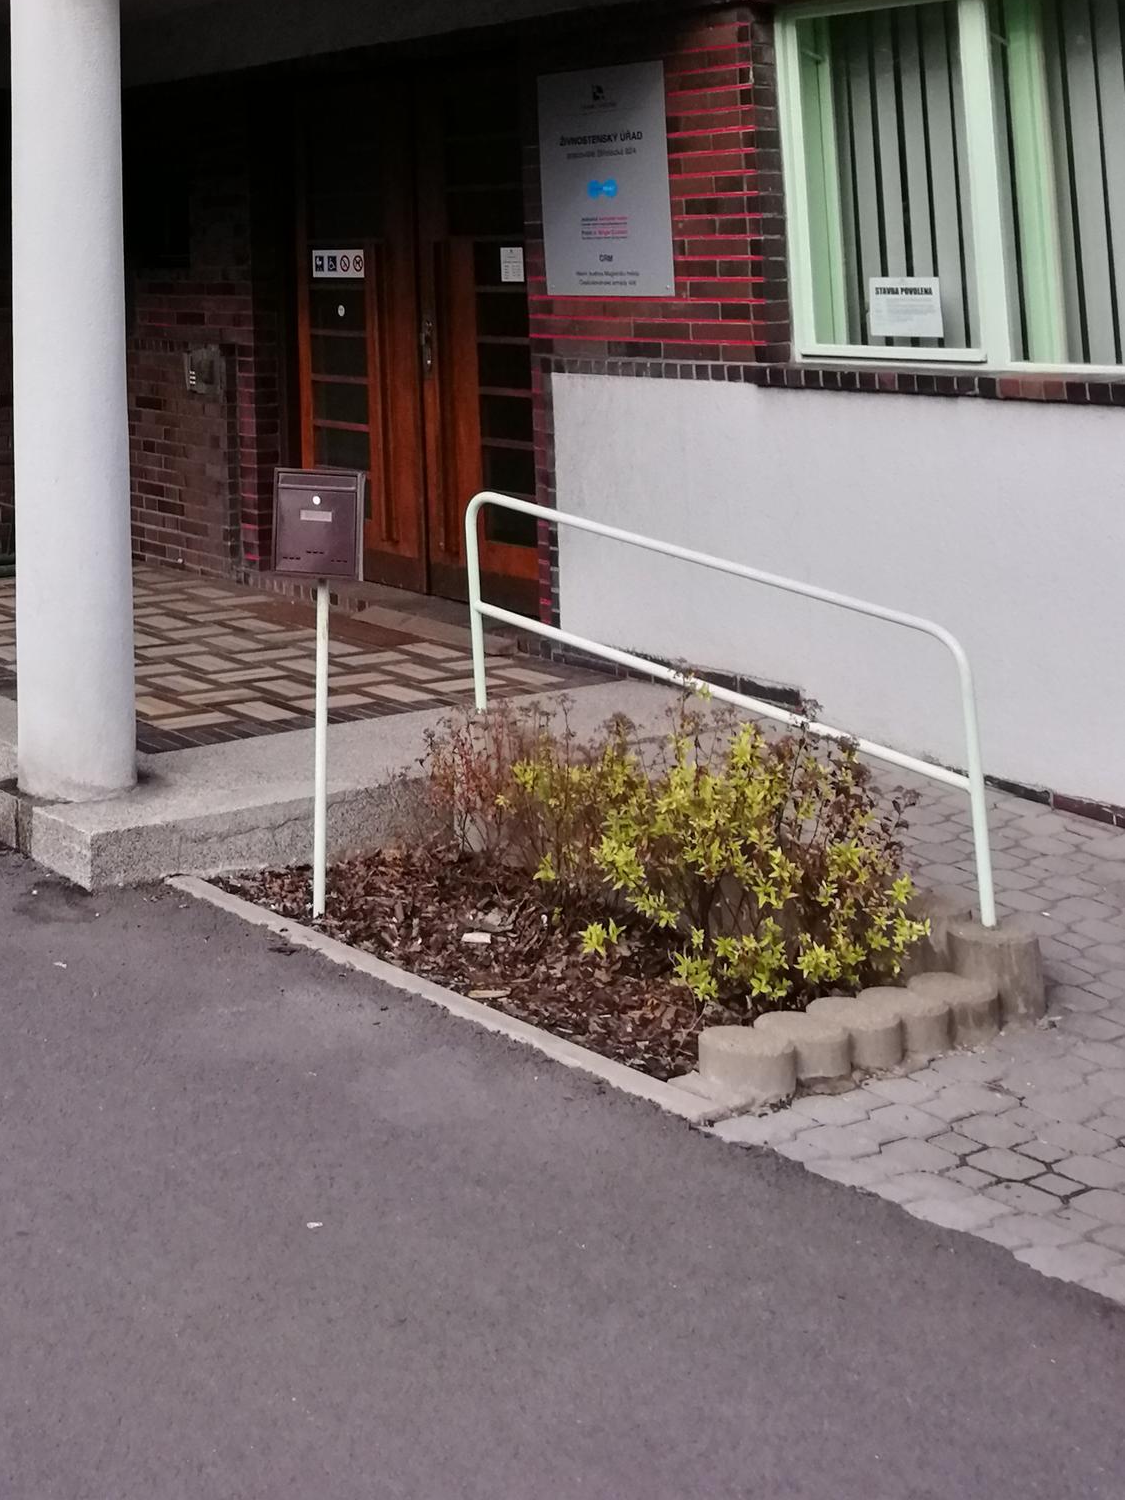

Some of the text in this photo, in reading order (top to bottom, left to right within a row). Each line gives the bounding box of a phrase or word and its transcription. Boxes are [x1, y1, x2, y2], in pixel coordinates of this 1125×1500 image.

[599, 254, 613, 262] CRM
[875, 286, 933, 296] STAVBA POVOLENA
